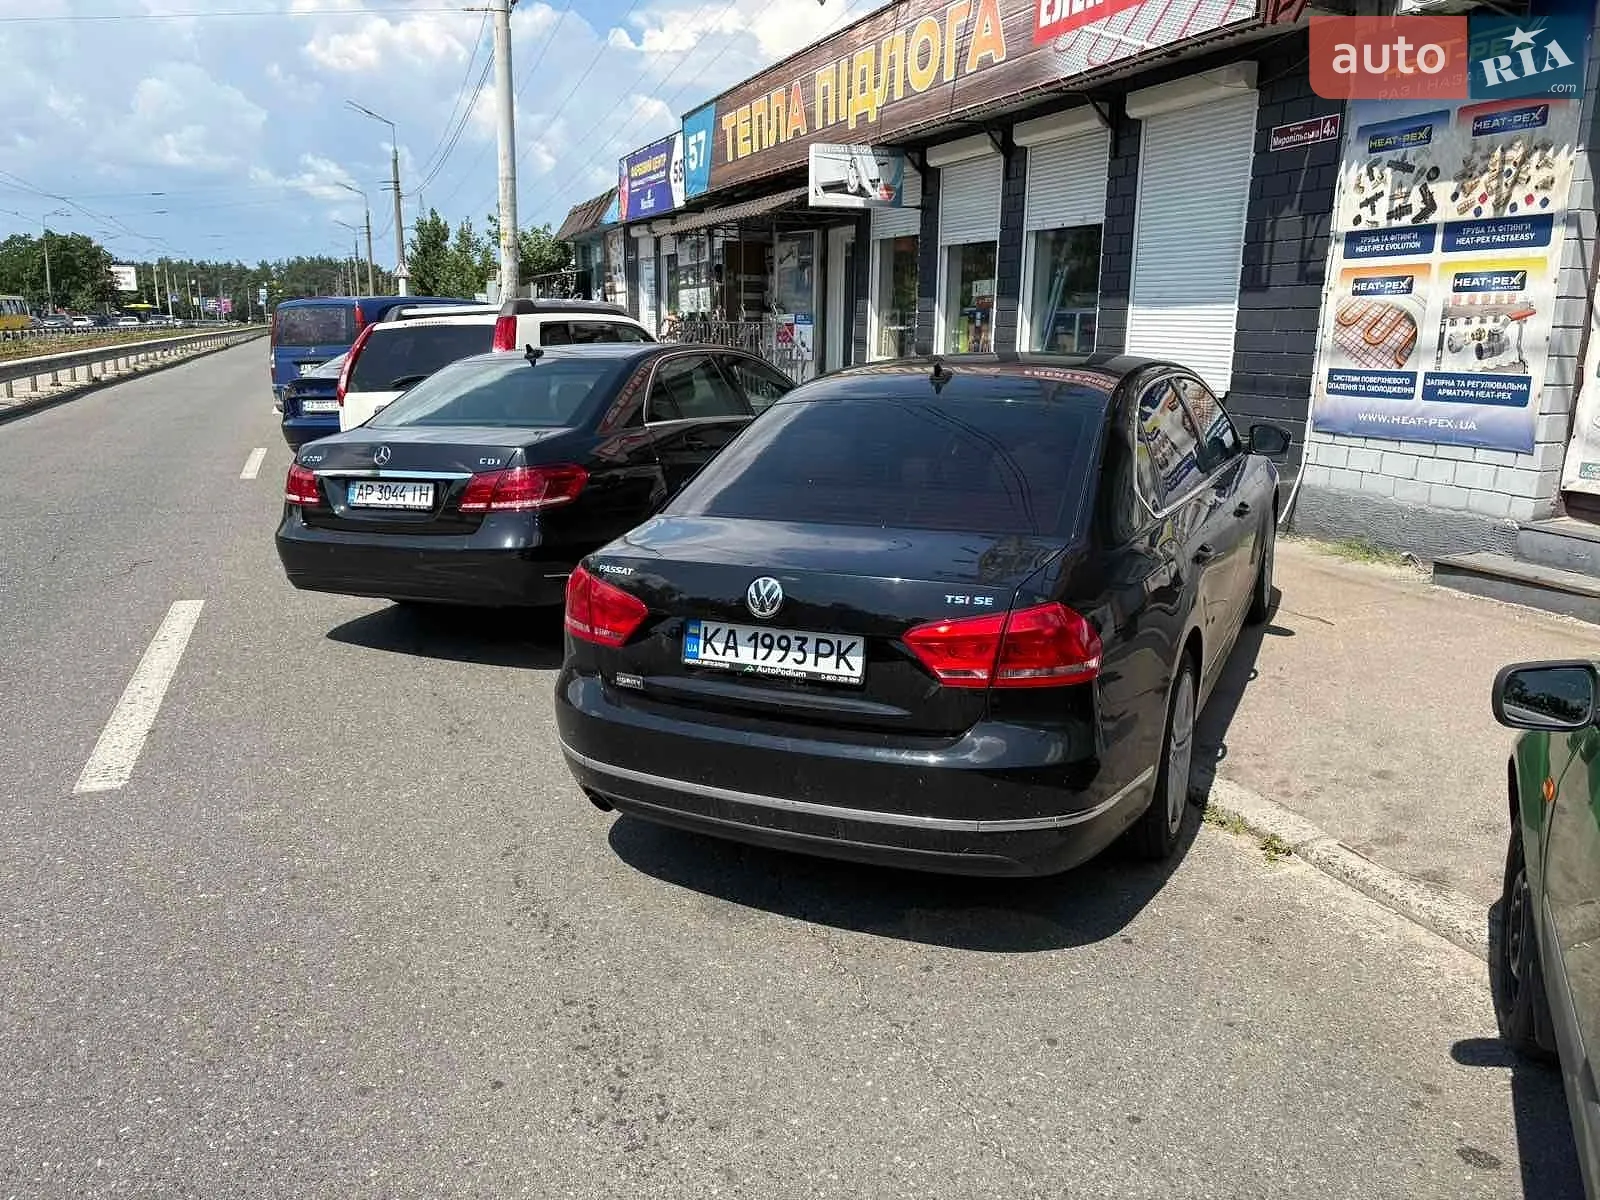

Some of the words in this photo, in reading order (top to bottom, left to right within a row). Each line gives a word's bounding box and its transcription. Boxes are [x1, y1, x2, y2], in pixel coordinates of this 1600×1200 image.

[721, 80, 808, 161] ТЕПЛА
[815, 0, 1006, 130] ПІДЛОГА
[1473, 109, 1543, 130] HEAT-PEX
[1369, 129, 1430, 149] HEAT-PEX
[688, 130, 707, 171] 57
[1455, 235, 1491, 246] HEAT-PEX
[1491, 231, 1536, 243] FAST&EASY
[1355, 243, 1385, 253] HEAT-PEX
[1385, 240, 1421, 251] EVOLUTION
[1352, 279, 1410, 291] HEAT-PEX
[1454, 274, 1522, 287] HEAT-PEX
[1333, 374, 1361, 384] СИСТЕМИ
[1361, 375, 1410, 385] ПОВЕРХНЕВОГО
[1425, 378, 1456, 388] ЗАПІРНА
[1457, 379, 1466, 388] ТА
[1466, 379, 1528, 391] РЕГУЛЮВАЛЬНА
[1327, 382, 1358, 392] ОПАЛЕННЯ
[1366, 384, 1415, 395] ОХОЛОДЖЕННЯ
[1437, 388, 1475, 398] АРМАТУРА
[1475, 390, 1513, 400] HEAT-PEX
[1358, 412, 1478, 431] WWW.HEAT-PEX.UA
[479, 457, 501, 465] CDI
[357, 484, 375, 501] AP
[376, 484, 406, 502] 3044
[412, 485, 431, 503] IH
[599, 564, 635, 576] PASSAT
[944, 594, 970, 605] TSI
[973, 596, 994, 606] SE
[687, 642, 698, 654] UA
[702, 626, 739, 658] KA
[747, 631, 808, 665] 1993
[814, 638, 855, 672] PK
[756, 665, 807, 679] AutoPodium
